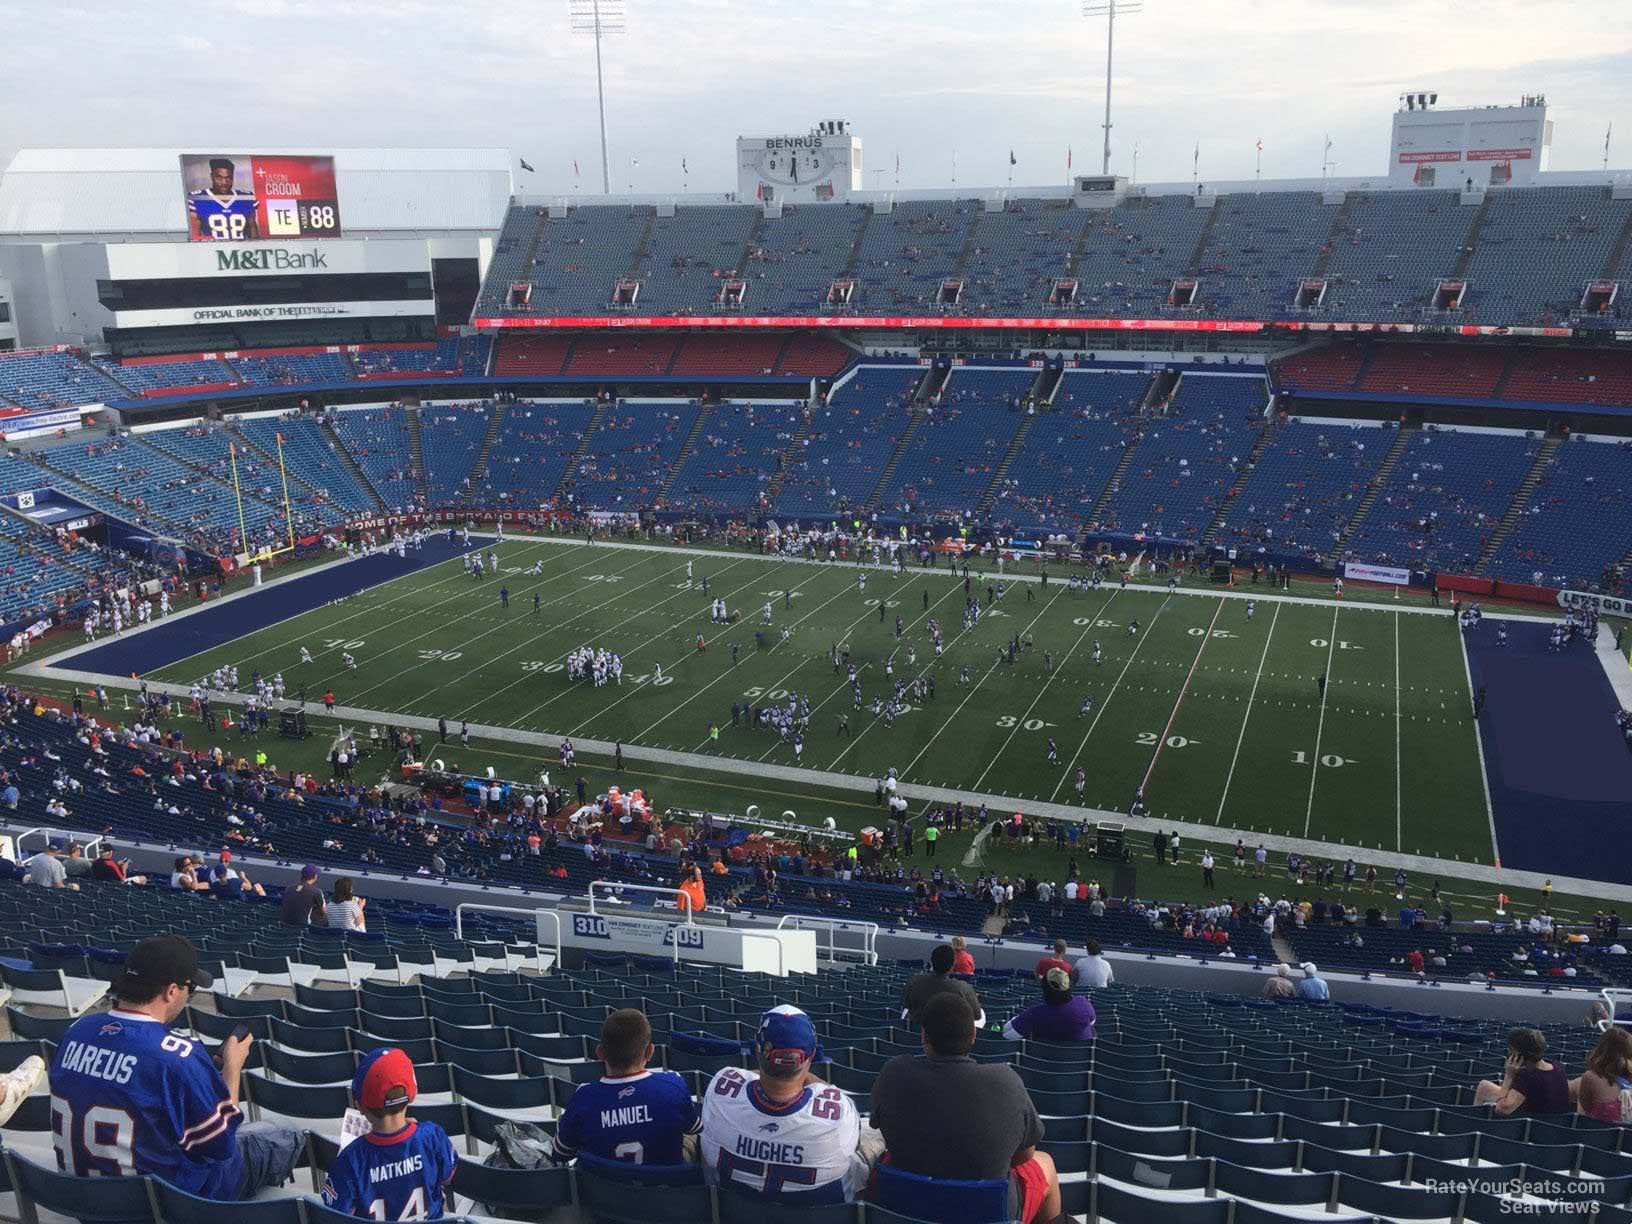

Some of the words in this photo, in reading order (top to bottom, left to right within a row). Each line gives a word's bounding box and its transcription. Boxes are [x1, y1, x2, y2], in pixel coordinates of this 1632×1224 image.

[766, 138, 822, 148] BENRUS
[770, 160, 776, 170] 9
[813, 159, 819, 169] 3
[265, 183, 301, 195] CROOM
[275, 209, 293, 225] TE
[310, 206, 334, 228] 88
[194, 310, 234, 320] OFFICIAL
[236, 308, 262, 318] BANK
[264, 308, 276, 317] OF
[278, 307, 296, 316] THE
[1603, 598, 1621, 610] GO
[325, 639, 365, 650] 10
[419, 649, 462, 661] 20
[522, 661, 564, 673] 30
[743, 687, 788, 700] 50
[996, 715, 1044, 731] 30
[1135, 732, 1188, 748] 20
[1289, 751, 1344, 768] 10
[575, 917, 608, 935] 310
[666, 926, 701, 945] 309
[161, 1028, 199, 1058] 9
[61, 1041, 137, 1084] DAREUS
[811, 1088, 841, 1120] 55
[601, 1105, 653, 1129] MANUEL
[736, 1134, 804, 1165] HUGHES
[370, 1154, 423, 1183] WATKINS
[368, 1186, 428, 1222] 14
